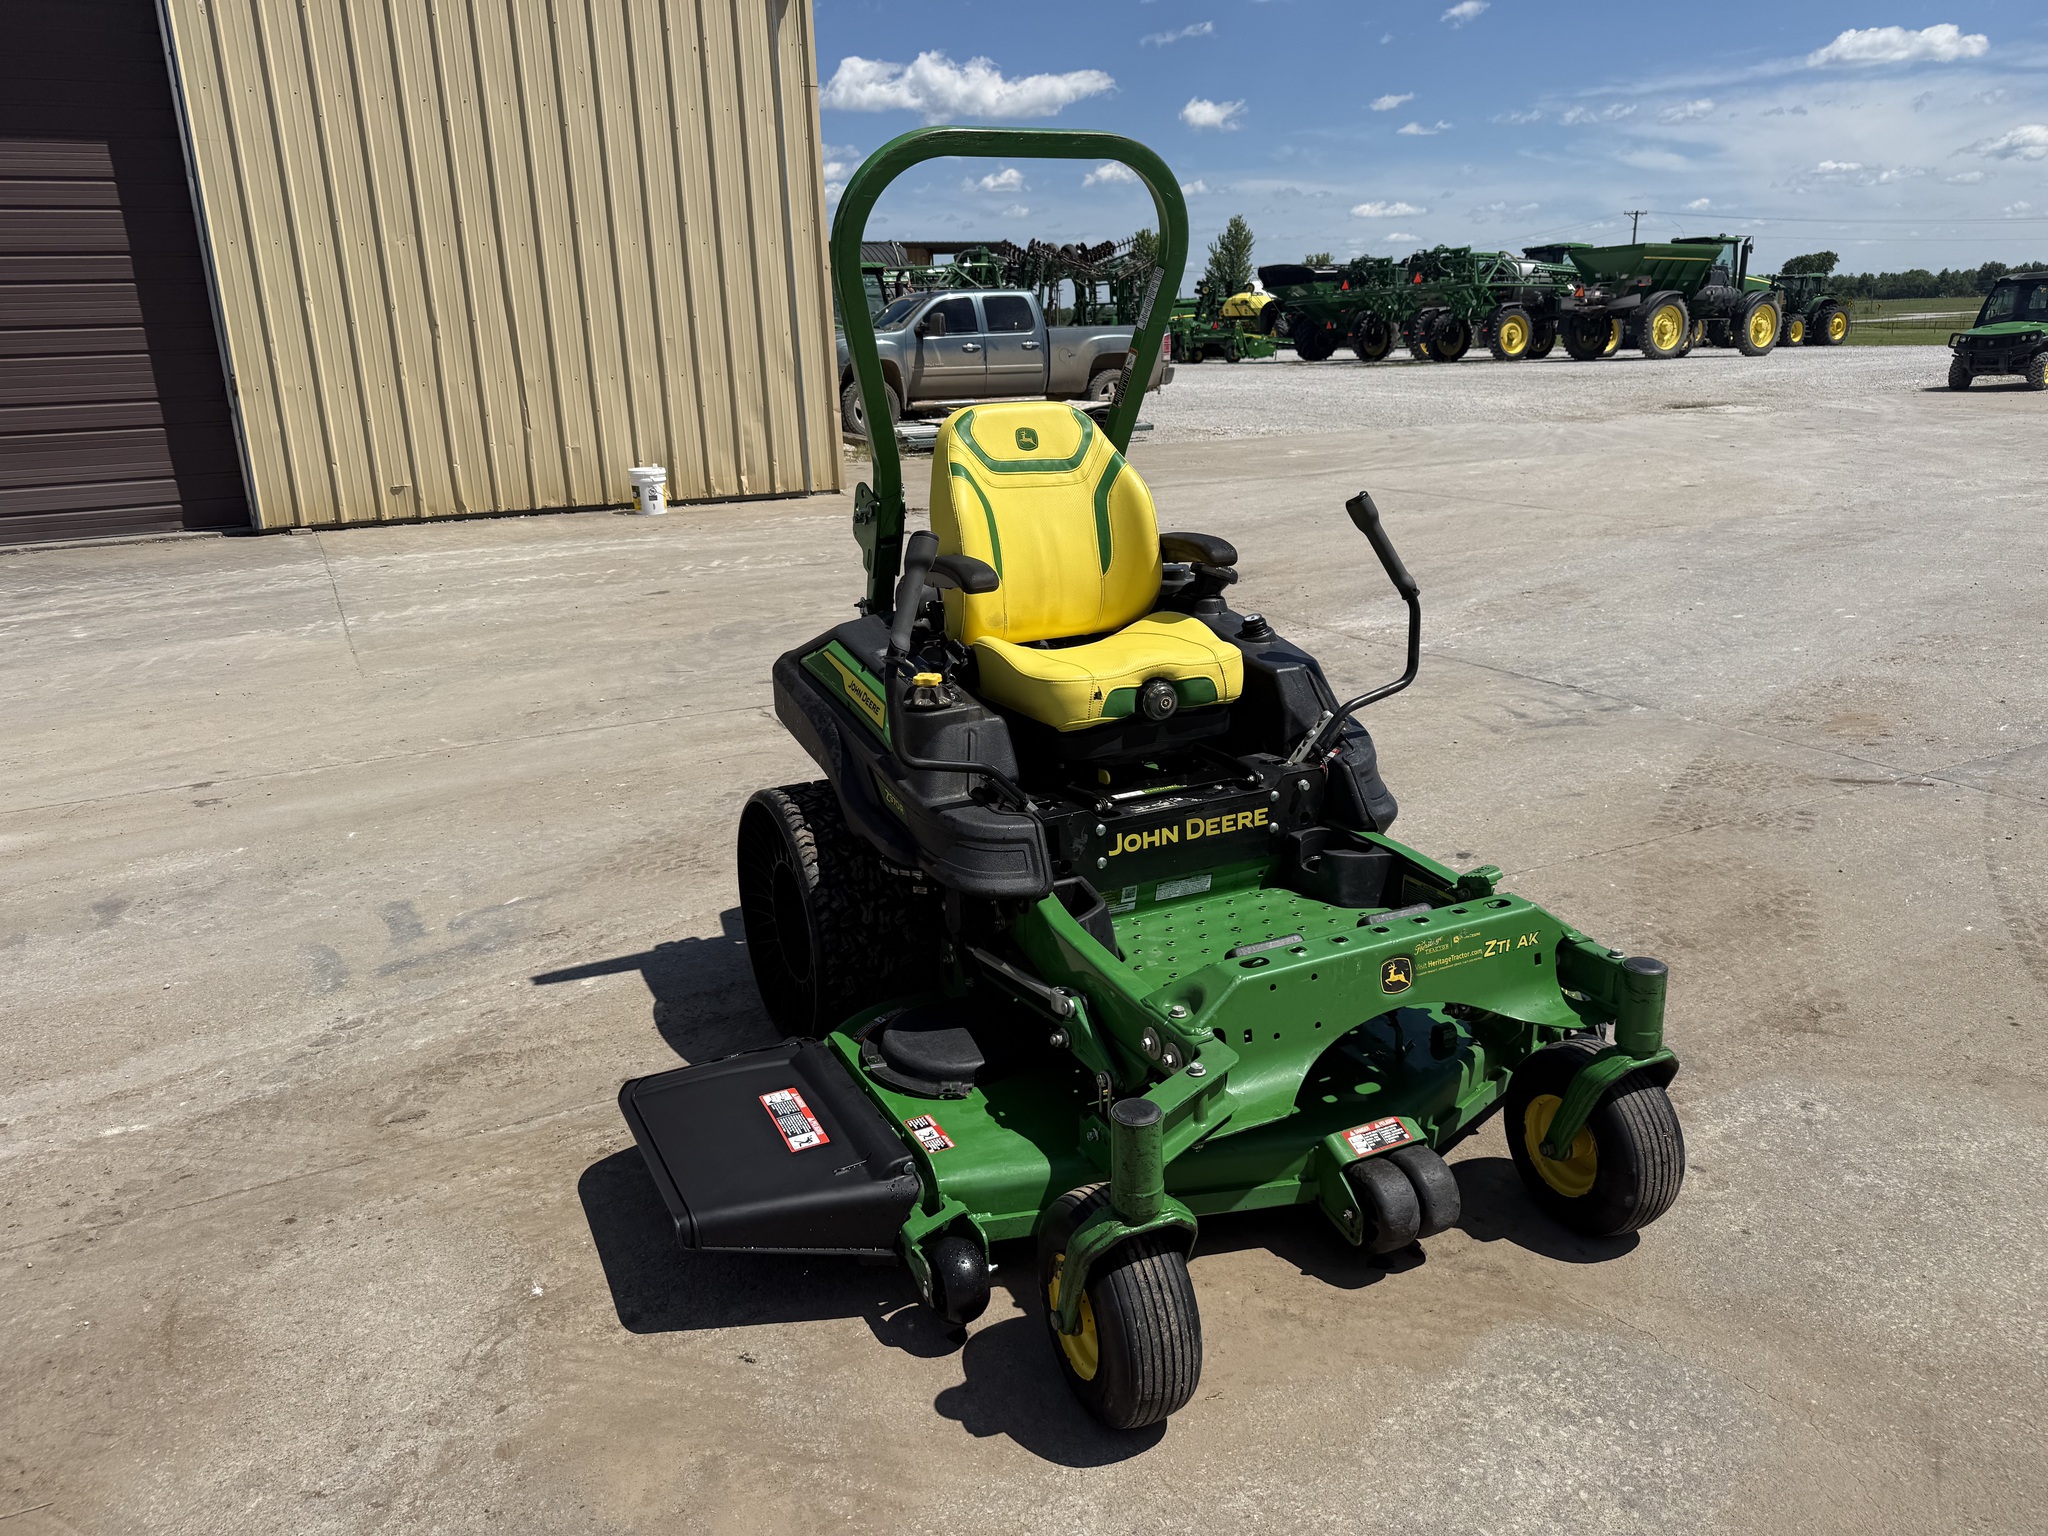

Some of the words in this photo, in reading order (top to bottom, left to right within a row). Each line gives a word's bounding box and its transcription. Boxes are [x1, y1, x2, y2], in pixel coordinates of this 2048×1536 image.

[847, 679, 864, 700] JOHN
[861, 691, 881, 716] DEERE
[1108, 824, 1180, 857] JOHN
[1186, 807, 1269, 842] DEERE
[1427, 950, 1483, 968] HeritageTractor.com
